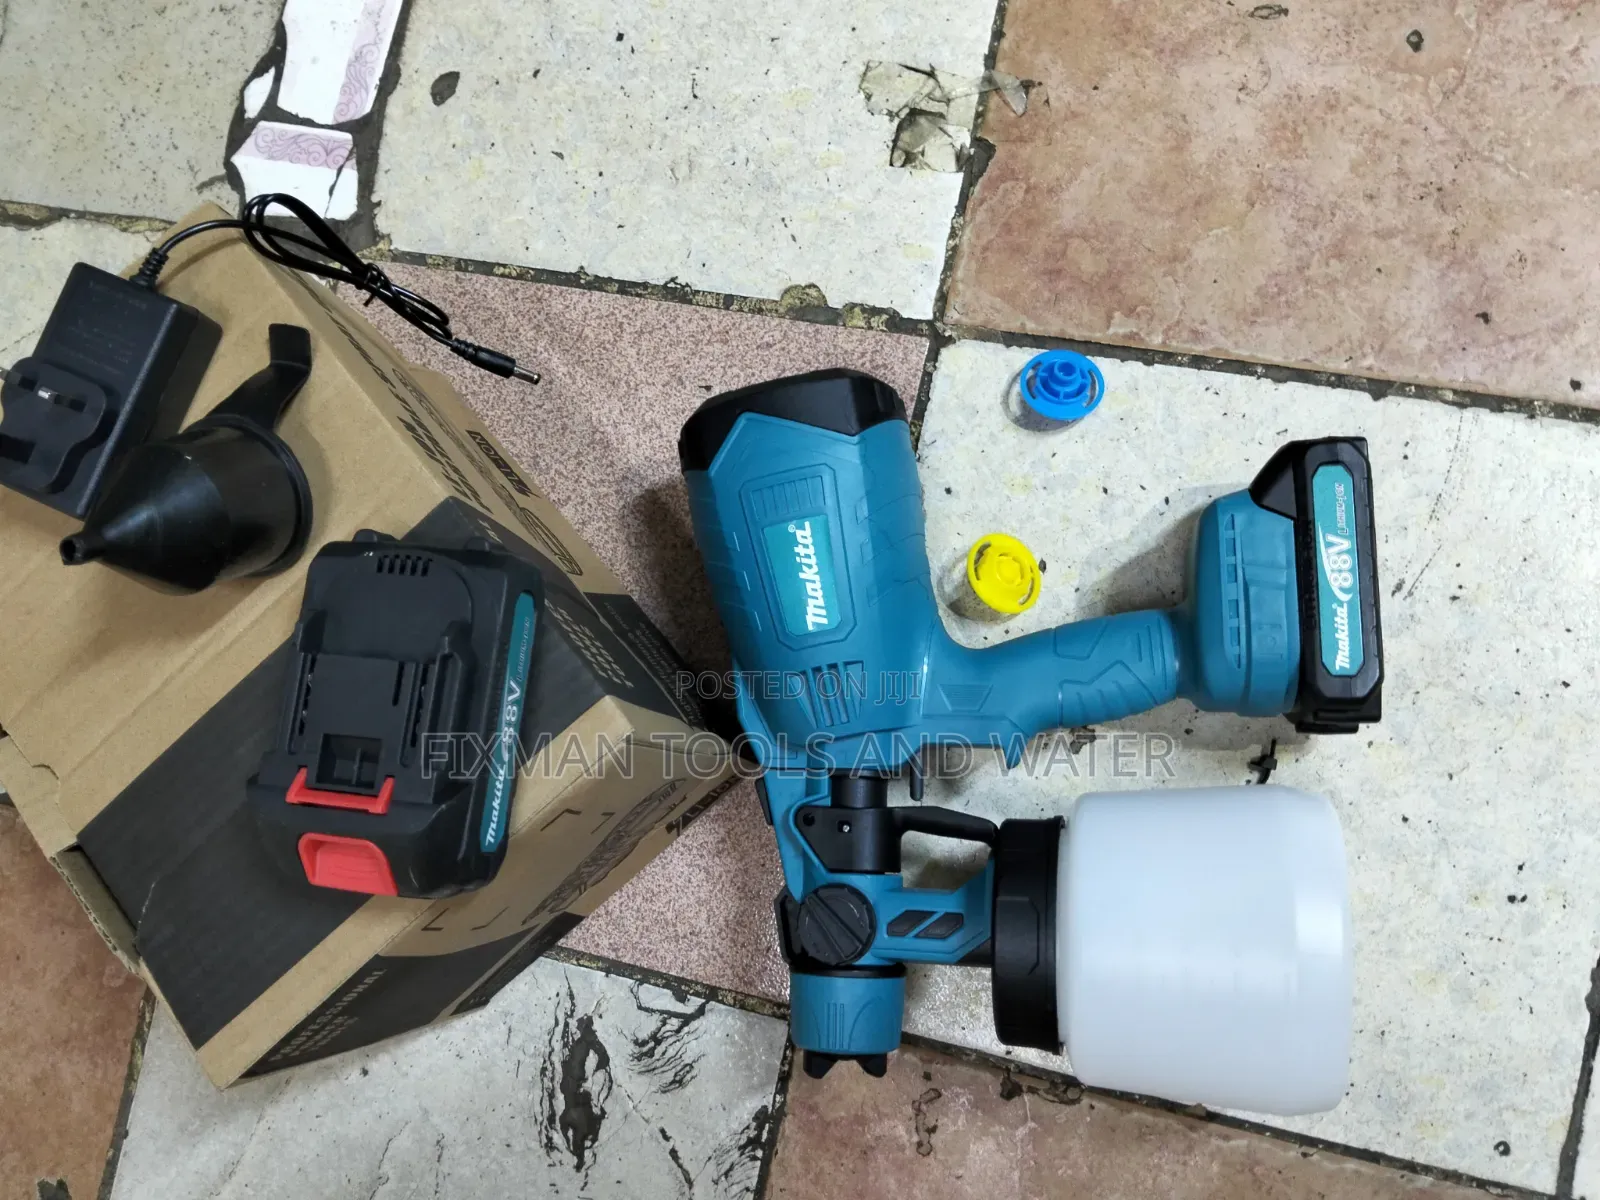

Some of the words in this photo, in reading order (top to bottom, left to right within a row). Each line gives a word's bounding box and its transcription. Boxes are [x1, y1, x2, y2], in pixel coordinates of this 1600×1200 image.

[470, 433, 520, 486] LI-ION
[1324, 532, 1354, 588] 88V
[580, 624, 634, 688] TOOLS
[501, 677, 521, 744] 88V
[268, 967, 387, 1061] PROFESSIONAL
